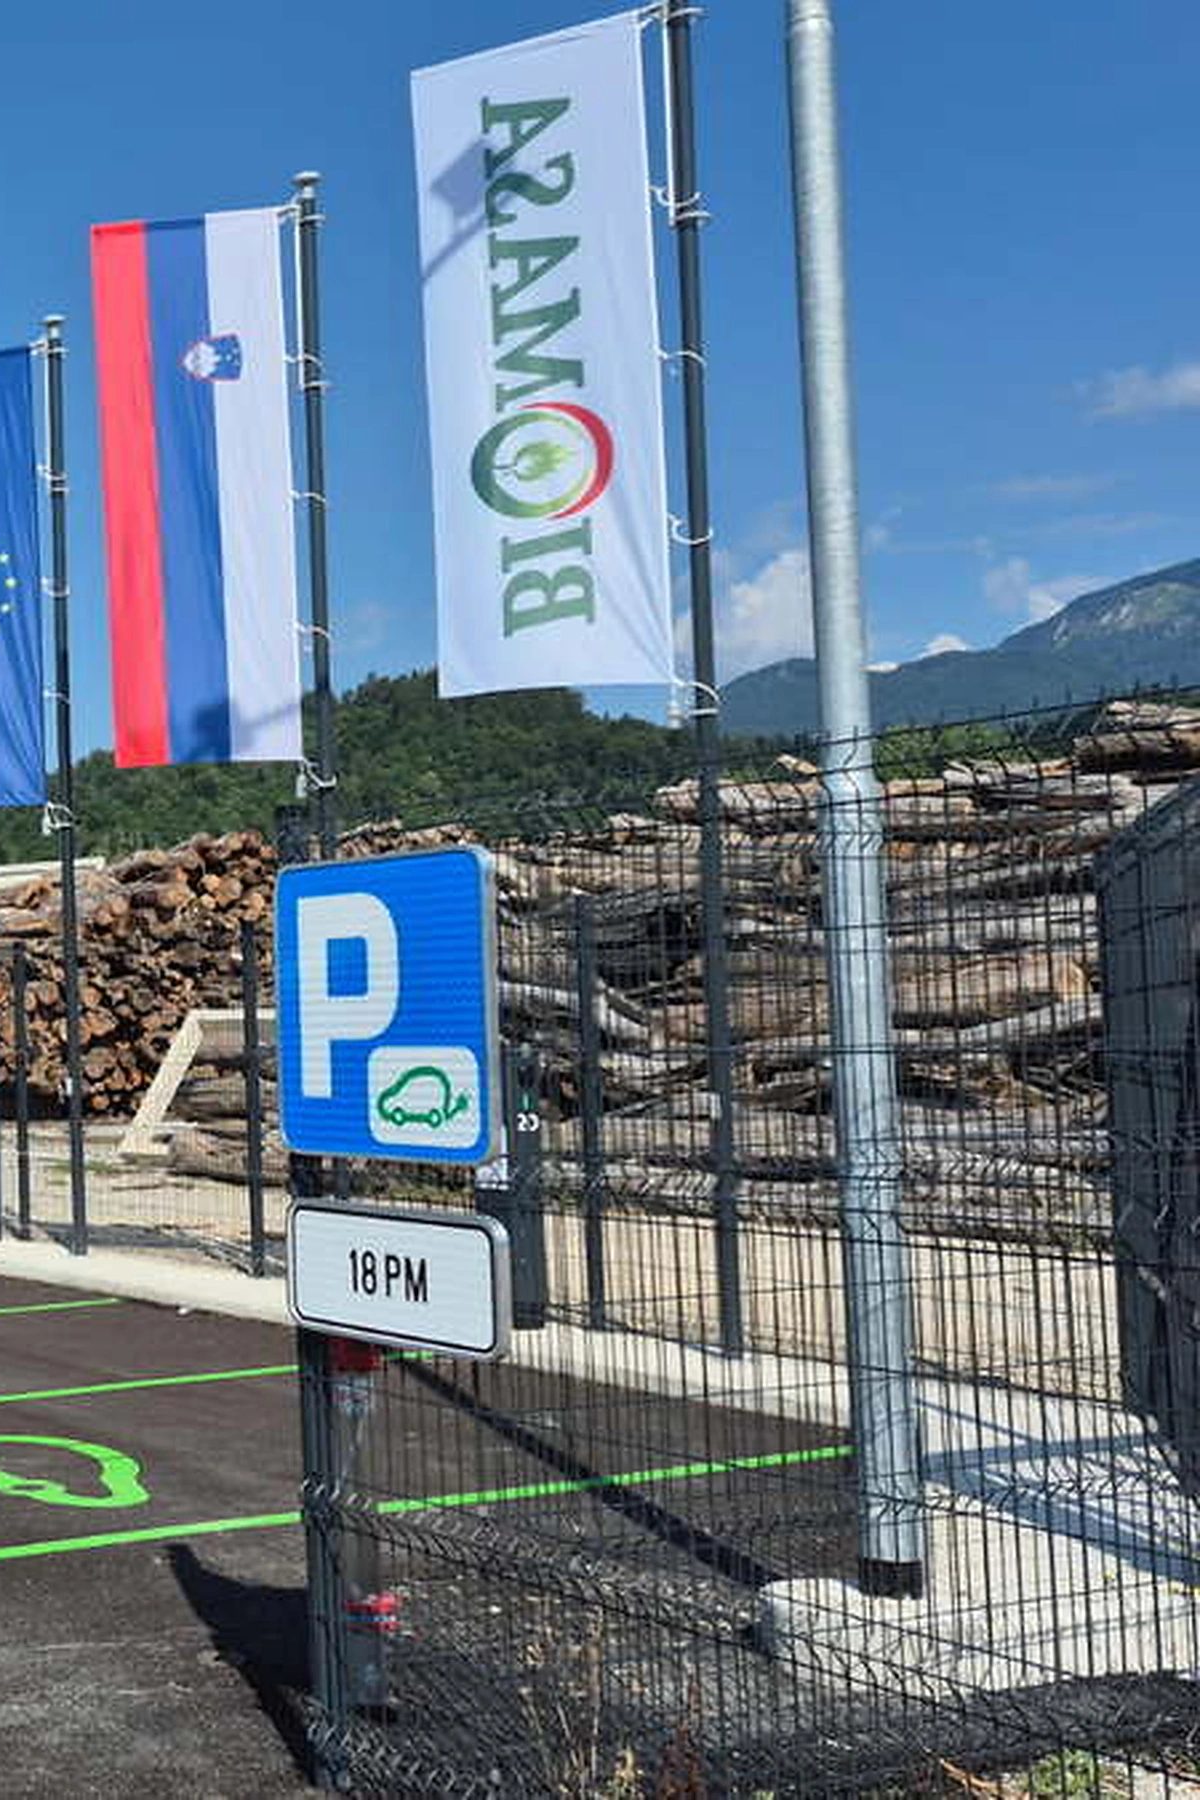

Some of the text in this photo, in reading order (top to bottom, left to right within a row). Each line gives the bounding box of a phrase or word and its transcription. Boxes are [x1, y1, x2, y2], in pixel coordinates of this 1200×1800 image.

[298, 892, 399, 1099] P
[349, 1249, 428, 1302] 18 PM
